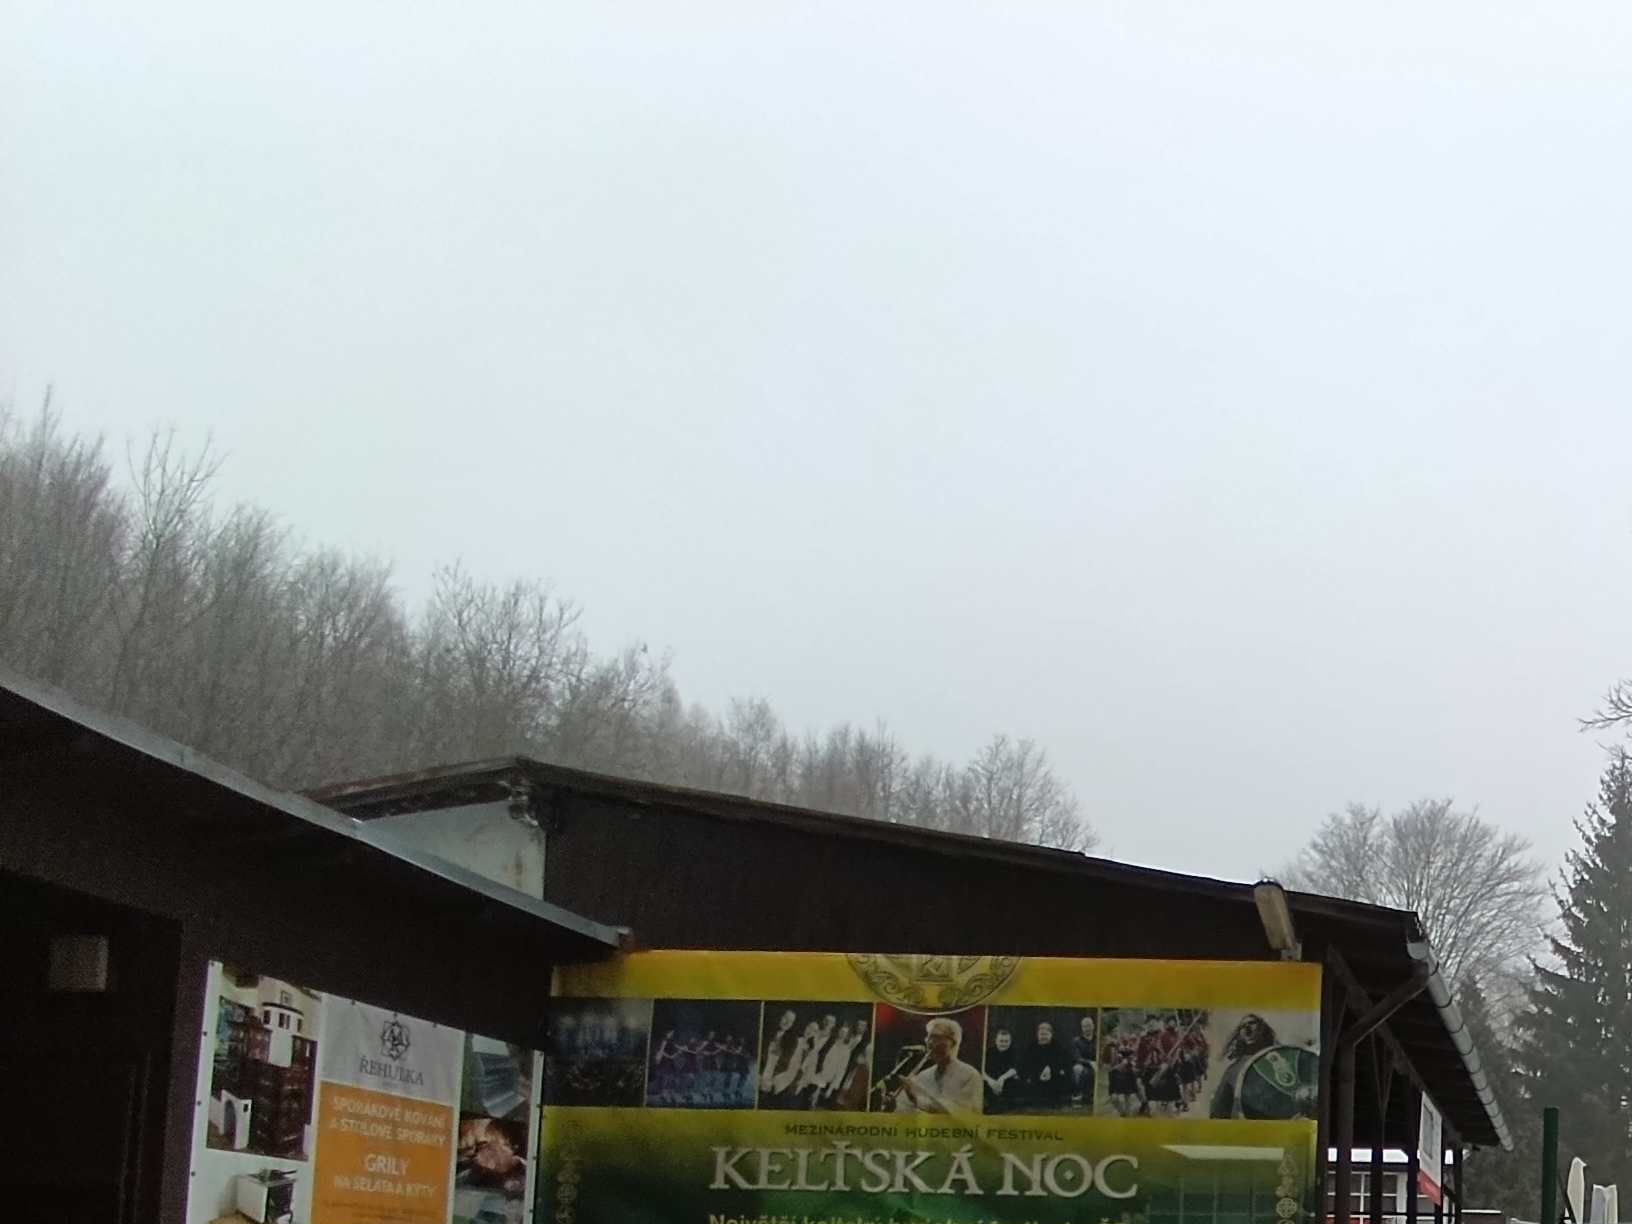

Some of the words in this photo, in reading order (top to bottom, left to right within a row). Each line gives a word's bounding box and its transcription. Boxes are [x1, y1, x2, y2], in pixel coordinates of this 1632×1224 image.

[359, 1055, 425, 1086] ŘEHULKA
[785, 1124, 898, 1138] MEZINÁRODNÍ
[905, 1127, 980, 1140] HUDEBNÍ
[986, 1129, 1064, 1141] FESTIVAL
[995, 1152, 1140, 1199] NOC
